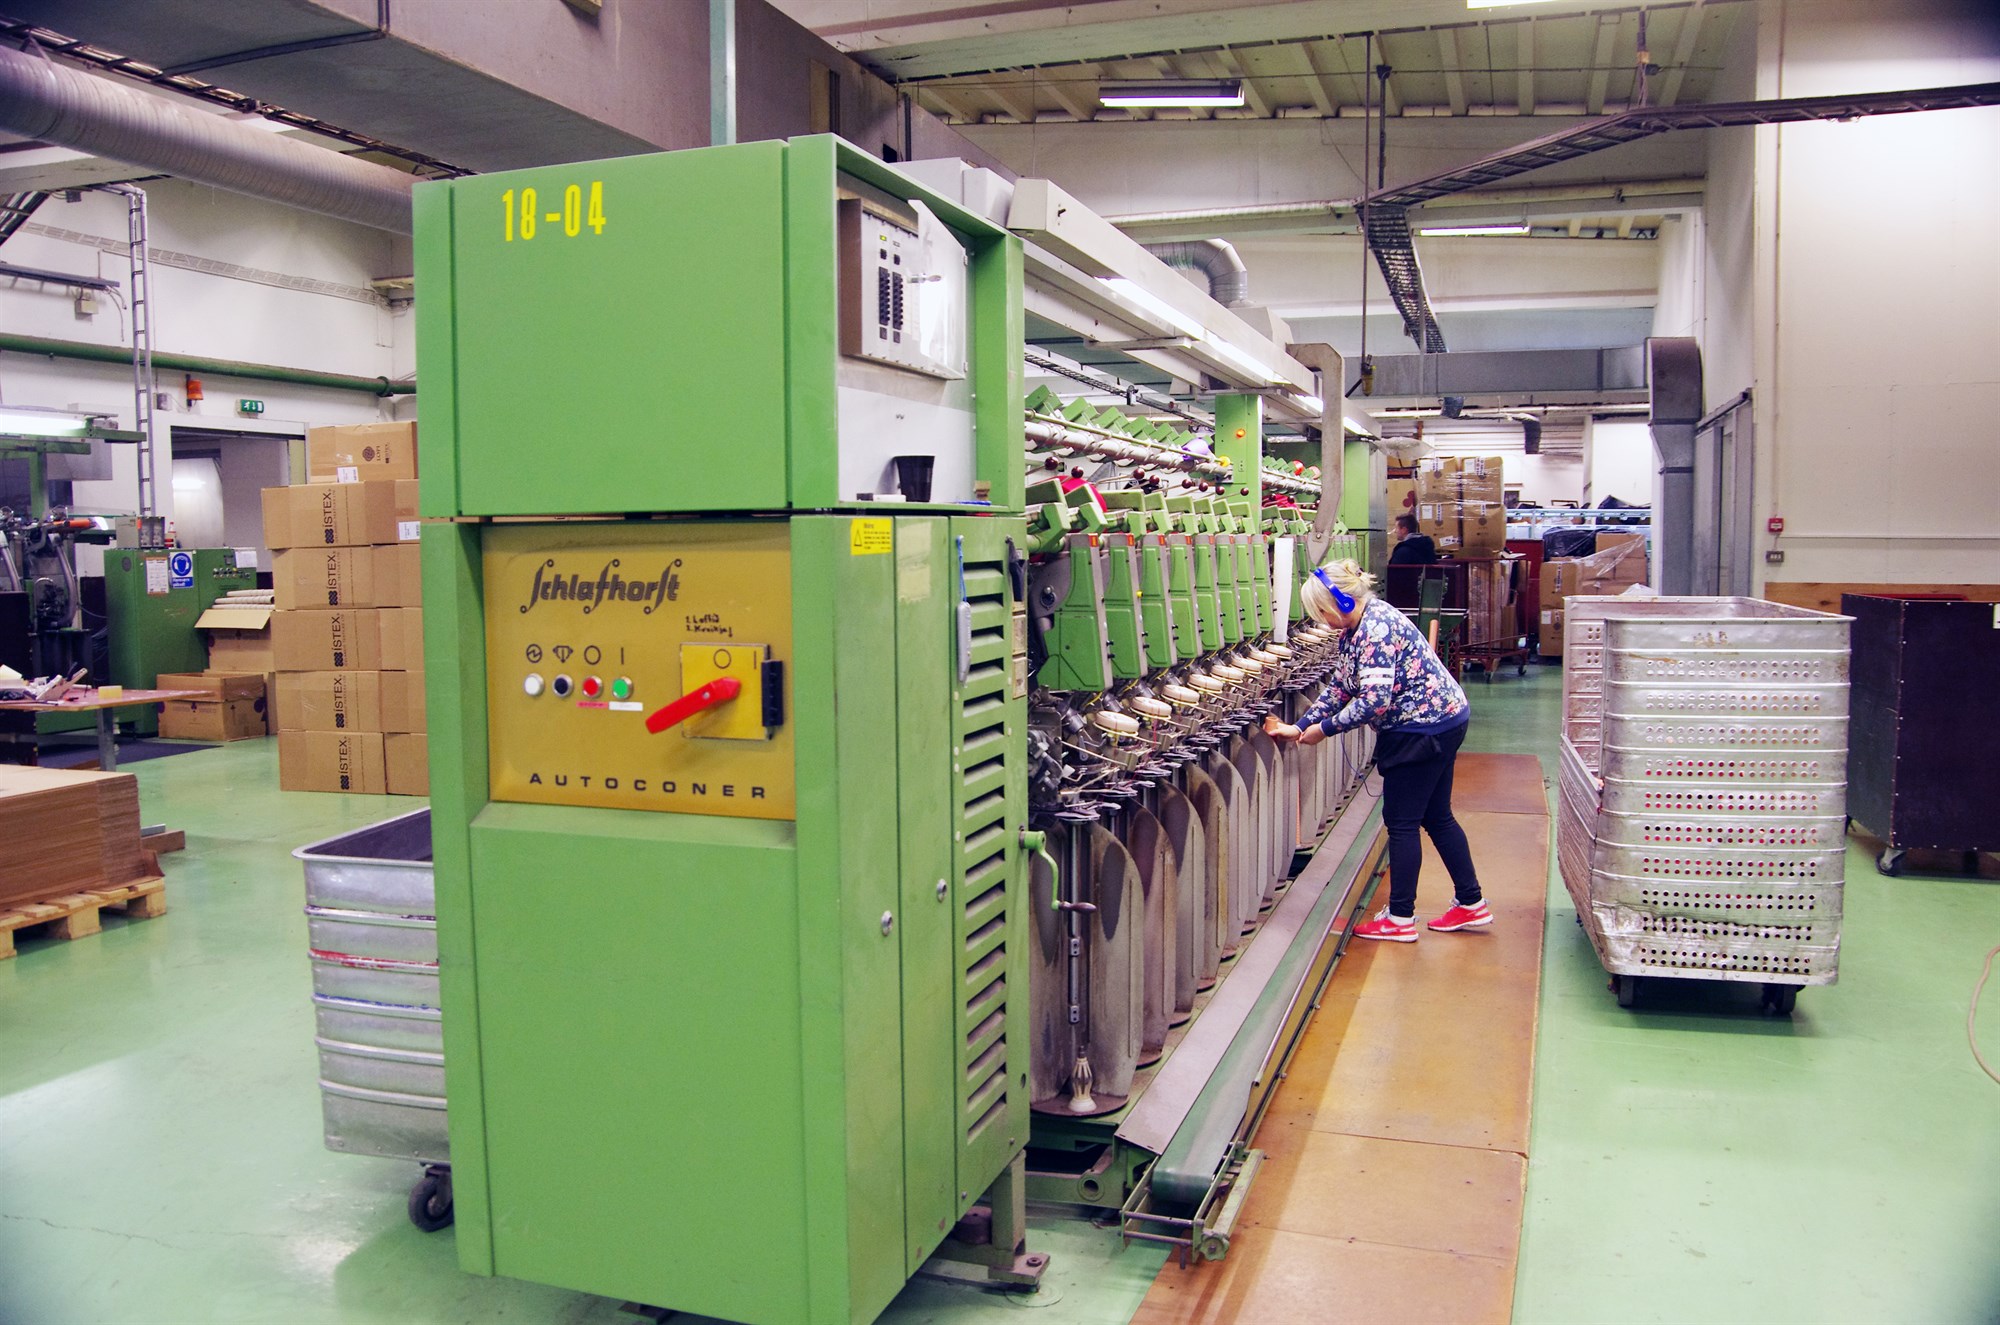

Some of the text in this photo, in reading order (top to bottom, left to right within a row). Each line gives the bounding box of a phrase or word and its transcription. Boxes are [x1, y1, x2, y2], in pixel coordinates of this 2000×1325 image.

[502, 180, 607, 242] 18-04
[322, 492, 333, 527] ÍSTEX
[326, 554, 337, 589] ÍSTEX
[520, 558, 682, 615] Schlafhorst
[331, 616, 343, 651] ÍSTEX
[333, 678, 344, 713] ÍSTEX
[339, 740, 349, 774] ÍSTEX
[529, 772, 766, 799] AUTOCONER
